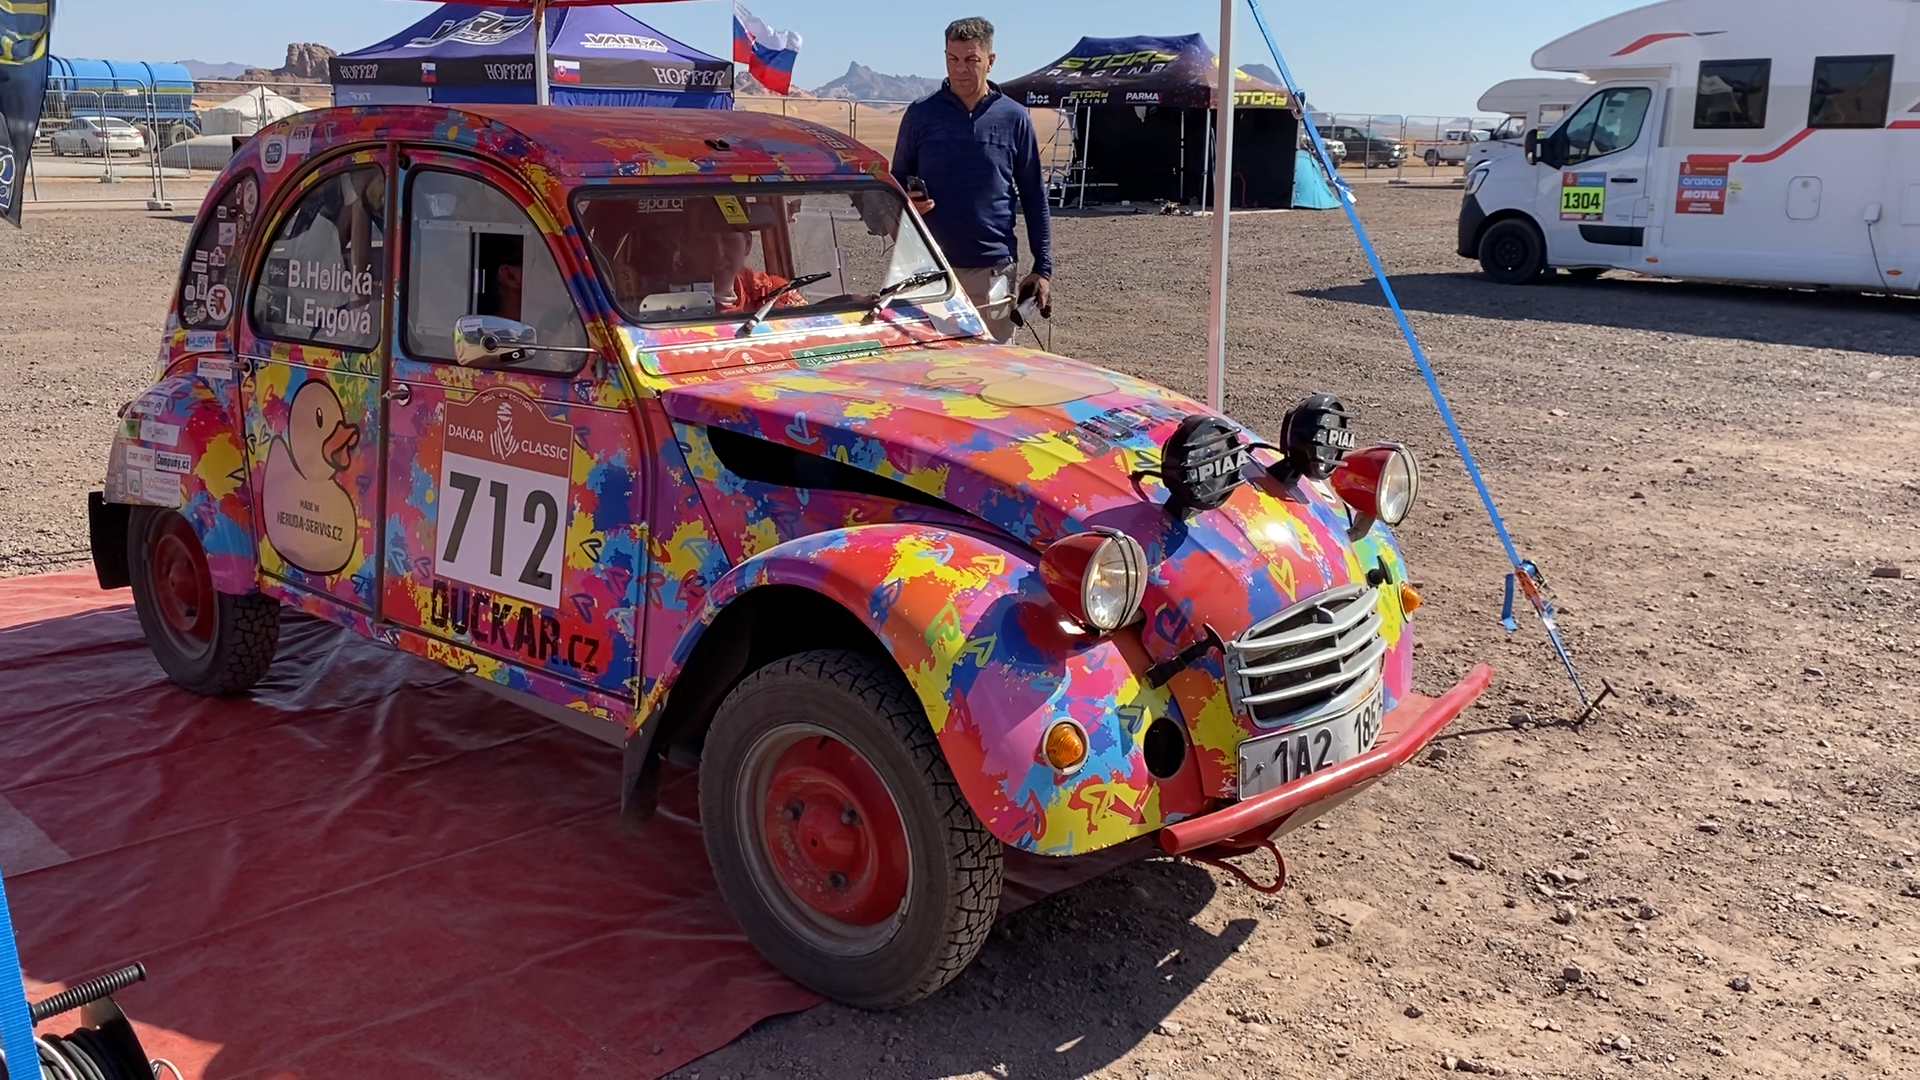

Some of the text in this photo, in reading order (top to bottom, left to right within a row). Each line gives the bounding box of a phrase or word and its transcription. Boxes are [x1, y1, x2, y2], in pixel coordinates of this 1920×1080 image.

[340, 63, 379, 79] HOFFER
[484, 63, 534, 80] HOFFER
[652, 66, 726, 86] HOFFER
[1047, 63, 1166, 78] RACING
[1126, 92, 1159, 101] PARMA
[1682, 177, 1723, 187] aramco
[1563, 192, 1601, 210] 1304
[1682, 189, 1720, 199] MOTUL
[287, 259, 373, 295] B.Holická
[285, 296, 371, 337] L.Engová
[448, 424, 568, 460] DAKAR CLASSIC
[1328, 429, 1355, 448] PIAA
[1198, 449, 1251, 482] PIAA
[276, 511, 343, 542] NERUDA-SERVIS.CZ
[443, 471, 558, 591] 712
[1271, 727, 1334, 784] 1A2
